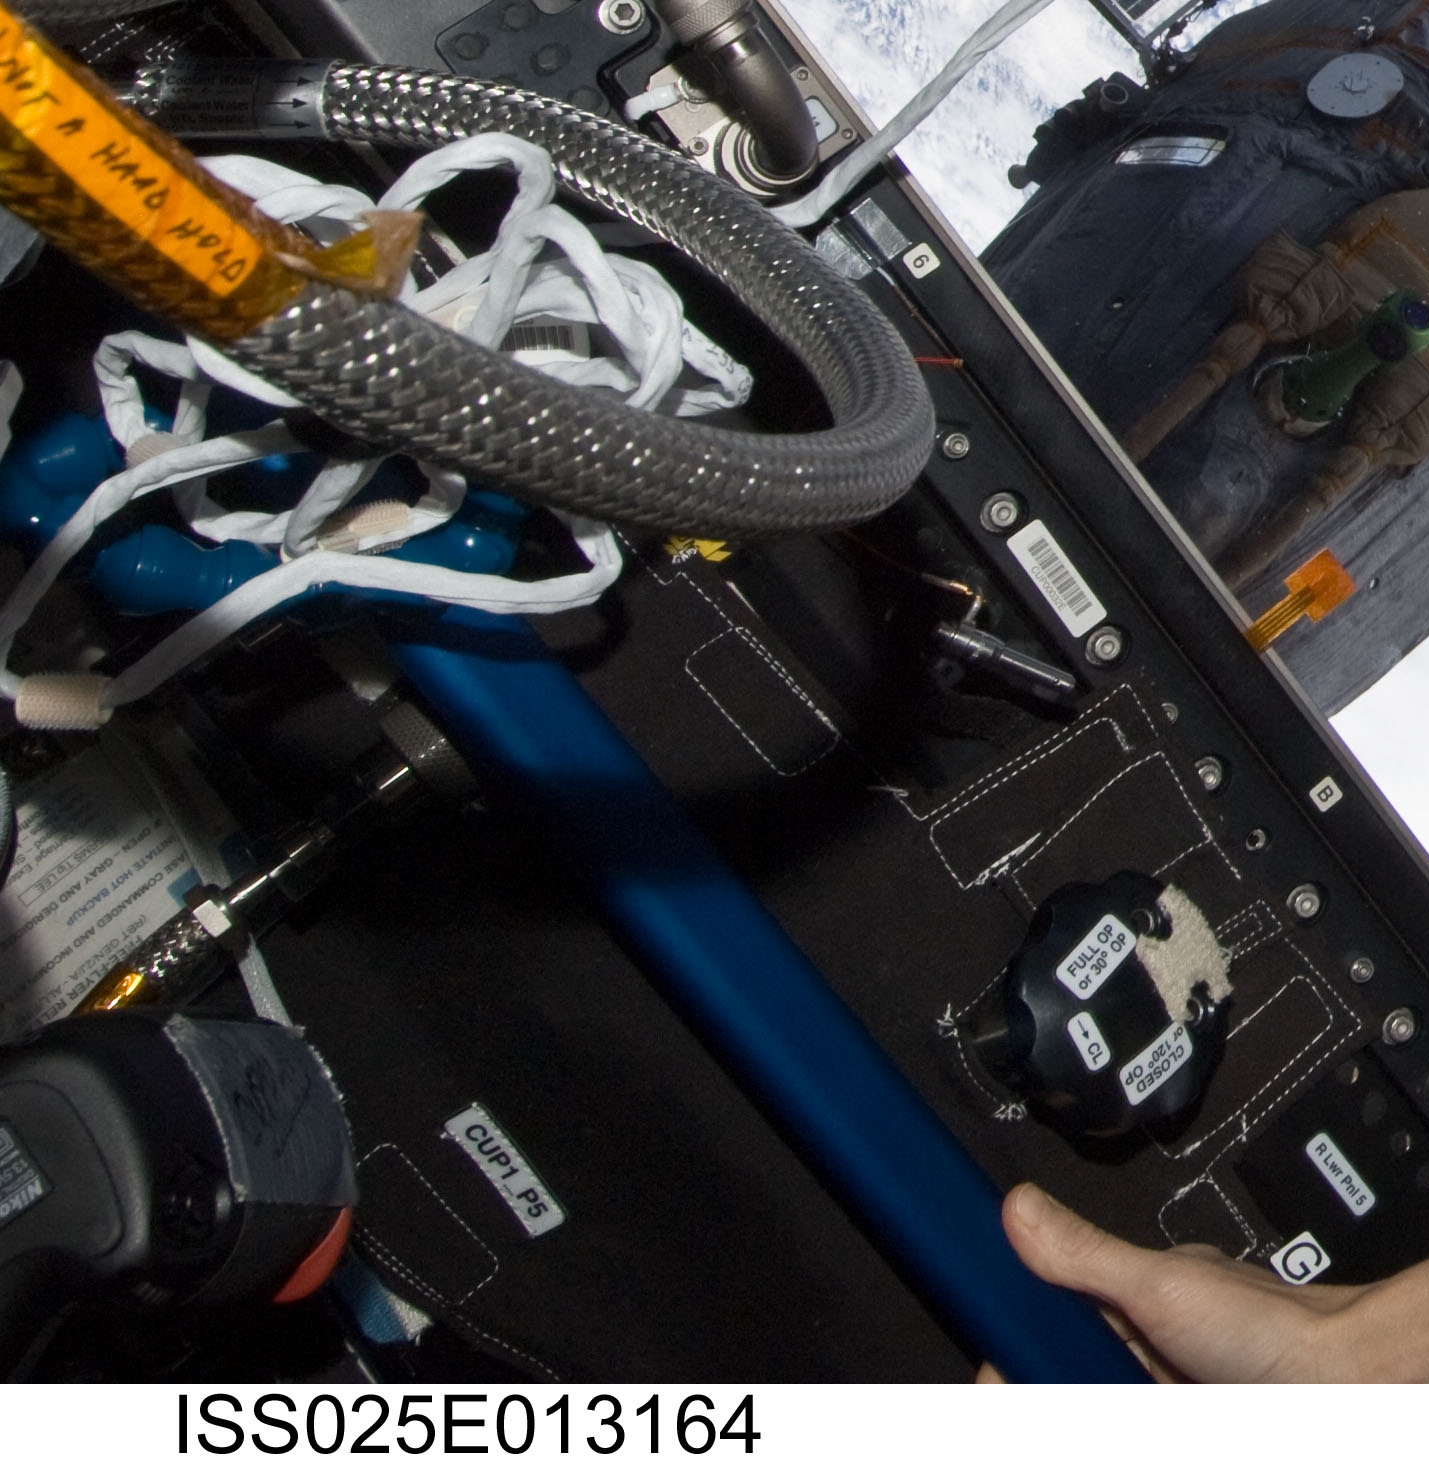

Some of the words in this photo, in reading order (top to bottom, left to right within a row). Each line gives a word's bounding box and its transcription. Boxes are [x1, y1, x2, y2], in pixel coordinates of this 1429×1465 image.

[1030, 564, 1067, 613] CUP00032E
[1316, 784, 1334, 804] B
[120, 825, 153, 854] OPEN
[33, 872, 58, 895] LEE
[81, 855, 115, 886] GRAY
[109, 868, 134, 891] HOT
[57, 881, 84, 905] AND
[64, 887, 110, 928] BACKUP
[95, 870, 165, 931] COMMANDED
[72, 926, 98, 949] AND
[1067, 942, 1100, 977] FULL
[1096, 923, 1117, 945] OP
[1077, 973, 1095, 991] or
[1109, 932, 1130, 954] OP
[1170, 1025, 1187, 1042] or
[1086, 1041, 1104, 1064] CL
[1121, 1063, 1145, 1087] OP
[1134, 1044, 1186, 1094] CLOSED
[463, 1119, 549, 1223] CUP1_P5
[1313, 1142, 1329, 1157] R
[1323, 1153, 1345, 1177] Lwr
[1340, 1175, 1361, 1198] Pnl
[1354, 1194, 1368, 1207] 5
[1282, 1242, 1322, 1280] G
